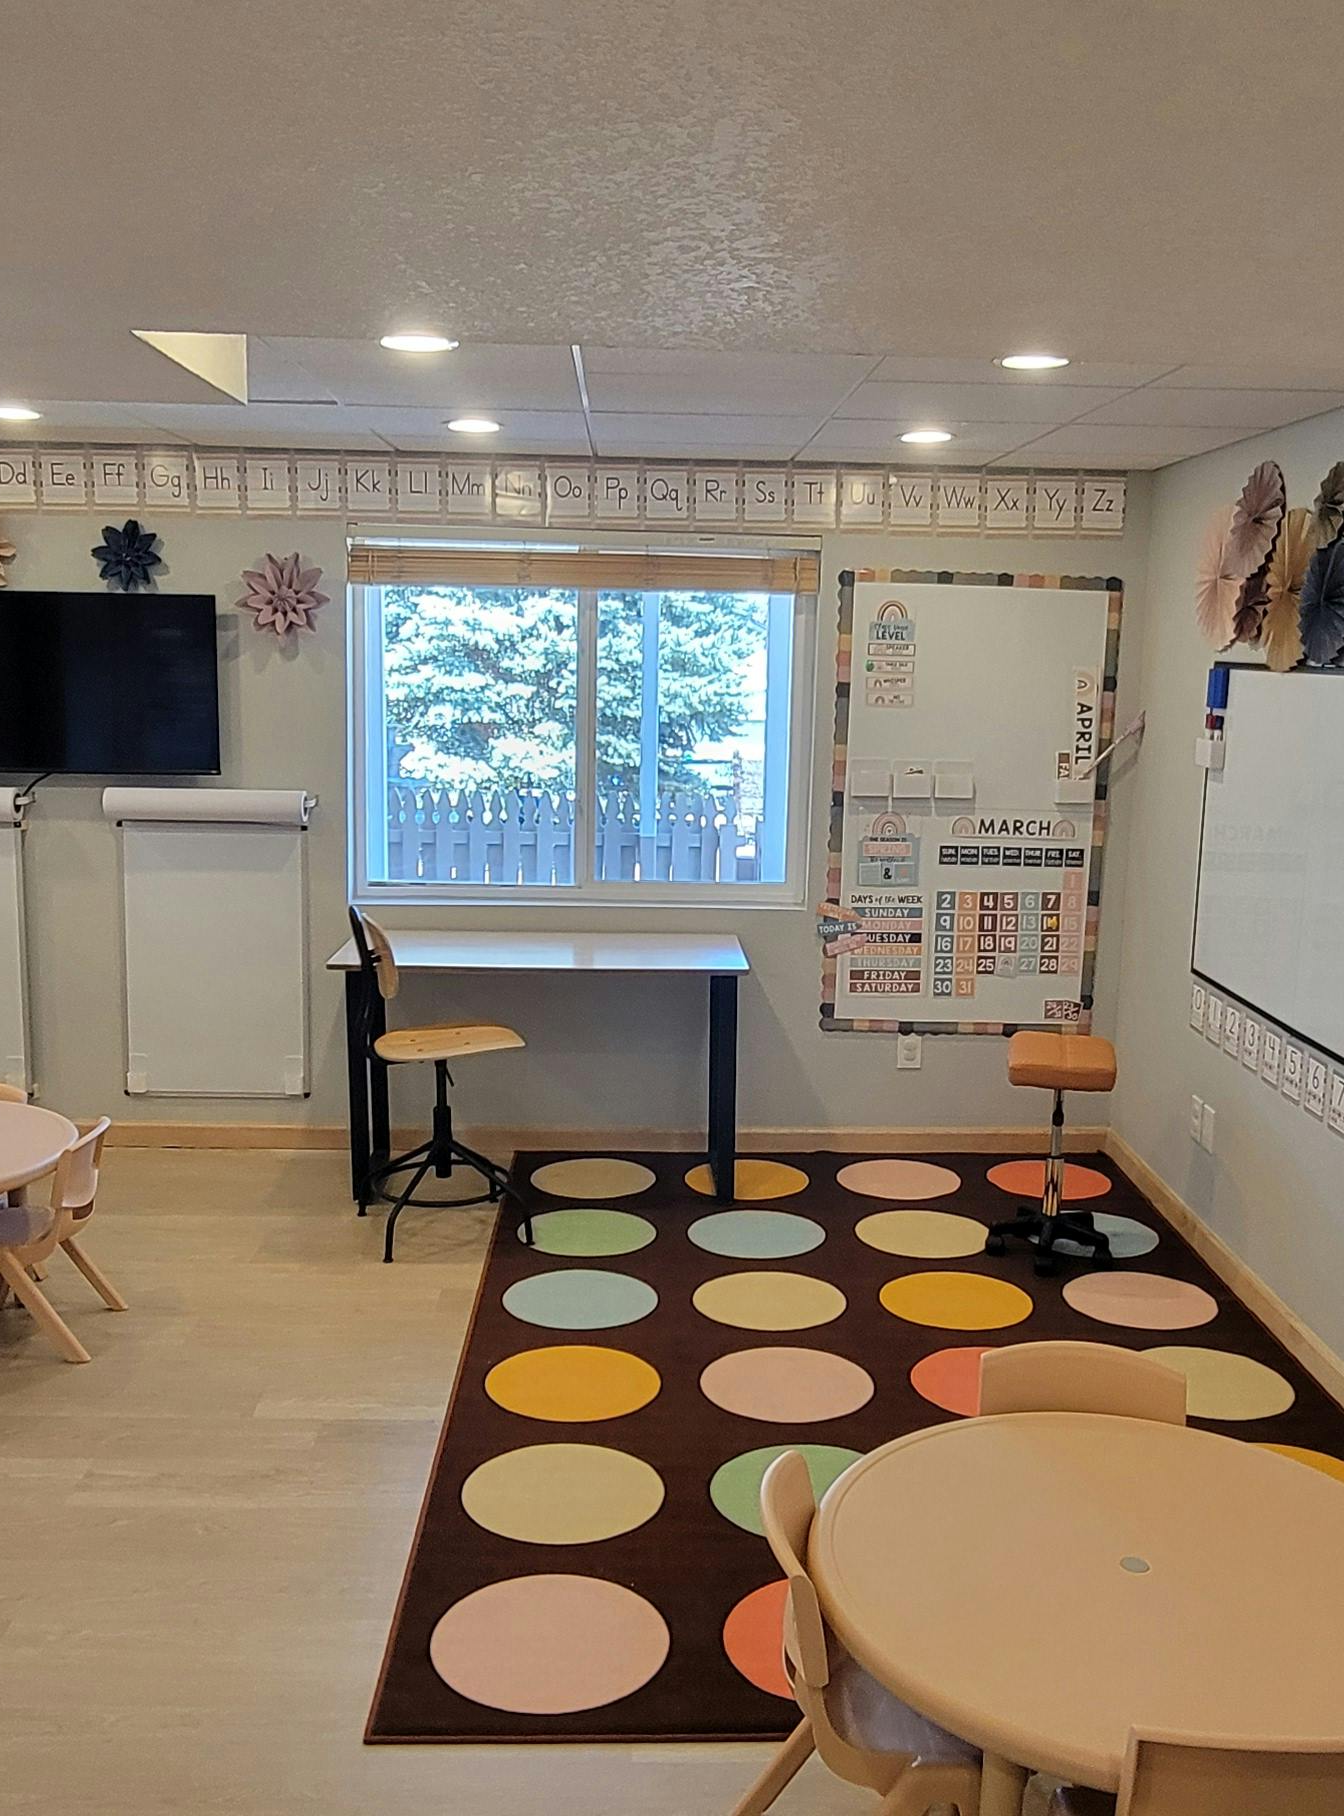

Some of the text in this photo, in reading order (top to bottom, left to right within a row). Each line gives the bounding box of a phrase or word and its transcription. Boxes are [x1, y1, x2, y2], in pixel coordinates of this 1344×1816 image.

[50, 462, 76, 486] Ee
[102, 462, 125, 487] Ff
[150, 464, 182, 498] Gg
[202, 466, 231, 490] Hh
[261, 467, 274, 491] Ii
[307, 467, 330, 501] Jj
[355, 469, 381, 493] Kk
[408, 470, 428, 494] Ll
[451, 472, 486, 496] Mm
[504, 473, 532, 497] Nn
[554, 475, 582, 498] Oo
[605, 476, 629, 510] Pp
[650, 478, 683, 512] Qq
[704, 479, 727, 502] Rr
[755, 480, 776, 503] Ss
[803, 481, 825, 505] Tt
[850, 482, 876, 505] Uu
[900, 485, 923, 508] Vv
[943, 486, 976, 509] Ww
[994, 488, 1019, 511] Xx
[1044, 488, 1068, 521] Yy
[1091, 488, 1114, 513] Zz
[876, 630, 906, 641] LEVEL
[1075, 702, 1093, 765] APRIL
[978, 818, 1052, 836] MARCH
[883, 867, 892, 880] &
[1070, 874, 1075, 888] 1
[851, 894, 874, 904] DAYS
[897, 894, 923, 904] WEEK
[941, 893, 1077, 909] 2 3 4 5 6 7 8
[864, 908, 910, 918] SUNDAY
[818, 922, 857, 934] TODAY IS
[862, 921, 912, 930] MONDAY
[940, 915, 951, 930] 9
[959, 916, 974, 930] 10
[984, 915, 992, 930] 11
[1002, 915, 1016, 930] 12
[1022, 915, 1036, 930] 13
[1065, 916, 1078, 930] 15
[937, 935, 1077, 951] 16 17 18 19 20 21 22
[857, 958, 914, 967] THURSDAY
[935, 958, 1078, 972] 23 24 25 27 28 29
[863, 971, 907, 980] FRIDAY
[856, 983, 914, 992] SATURDAY
[934, 981, 972, 993] 30 31
[1194, 988, 1202, 1010] 0
[1228, 1011, 1237, 1035] 2
[1247, 1023, 1256, 1048] 3
[1267, 1035, 1277, 1061] 4
[1288, 1050, 1297, 1076] 5
[1312, 1065, 1320, 1090] 6
